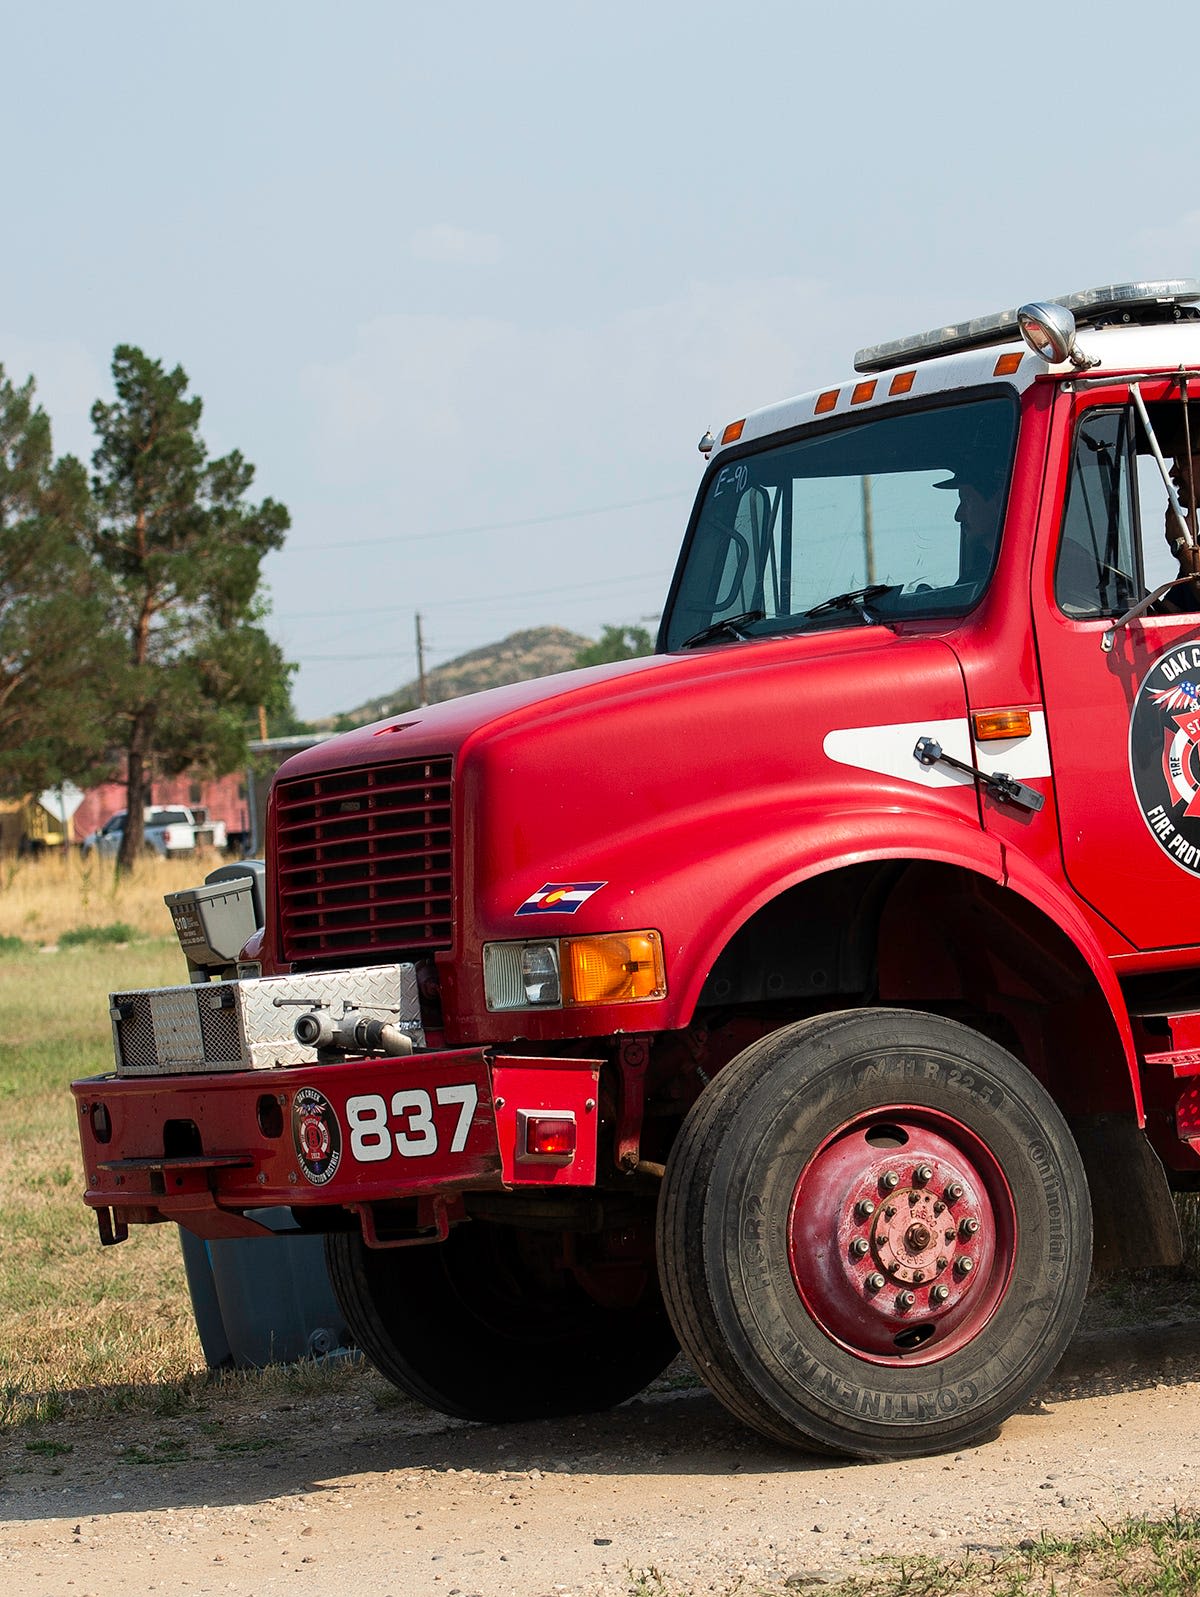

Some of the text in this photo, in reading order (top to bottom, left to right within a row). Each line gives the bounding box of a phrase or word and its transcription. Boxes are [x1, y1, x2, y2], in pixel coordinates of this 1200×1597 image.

[1160, 652, 1192, 682] OAK
[1170, 756, 1182, 778] FIRE
[1147, 804, 1174, 841] FIRE
[346, 1084, 478, 1162] 837
[776, 1332, 979, 1421] CONTINENTAL
